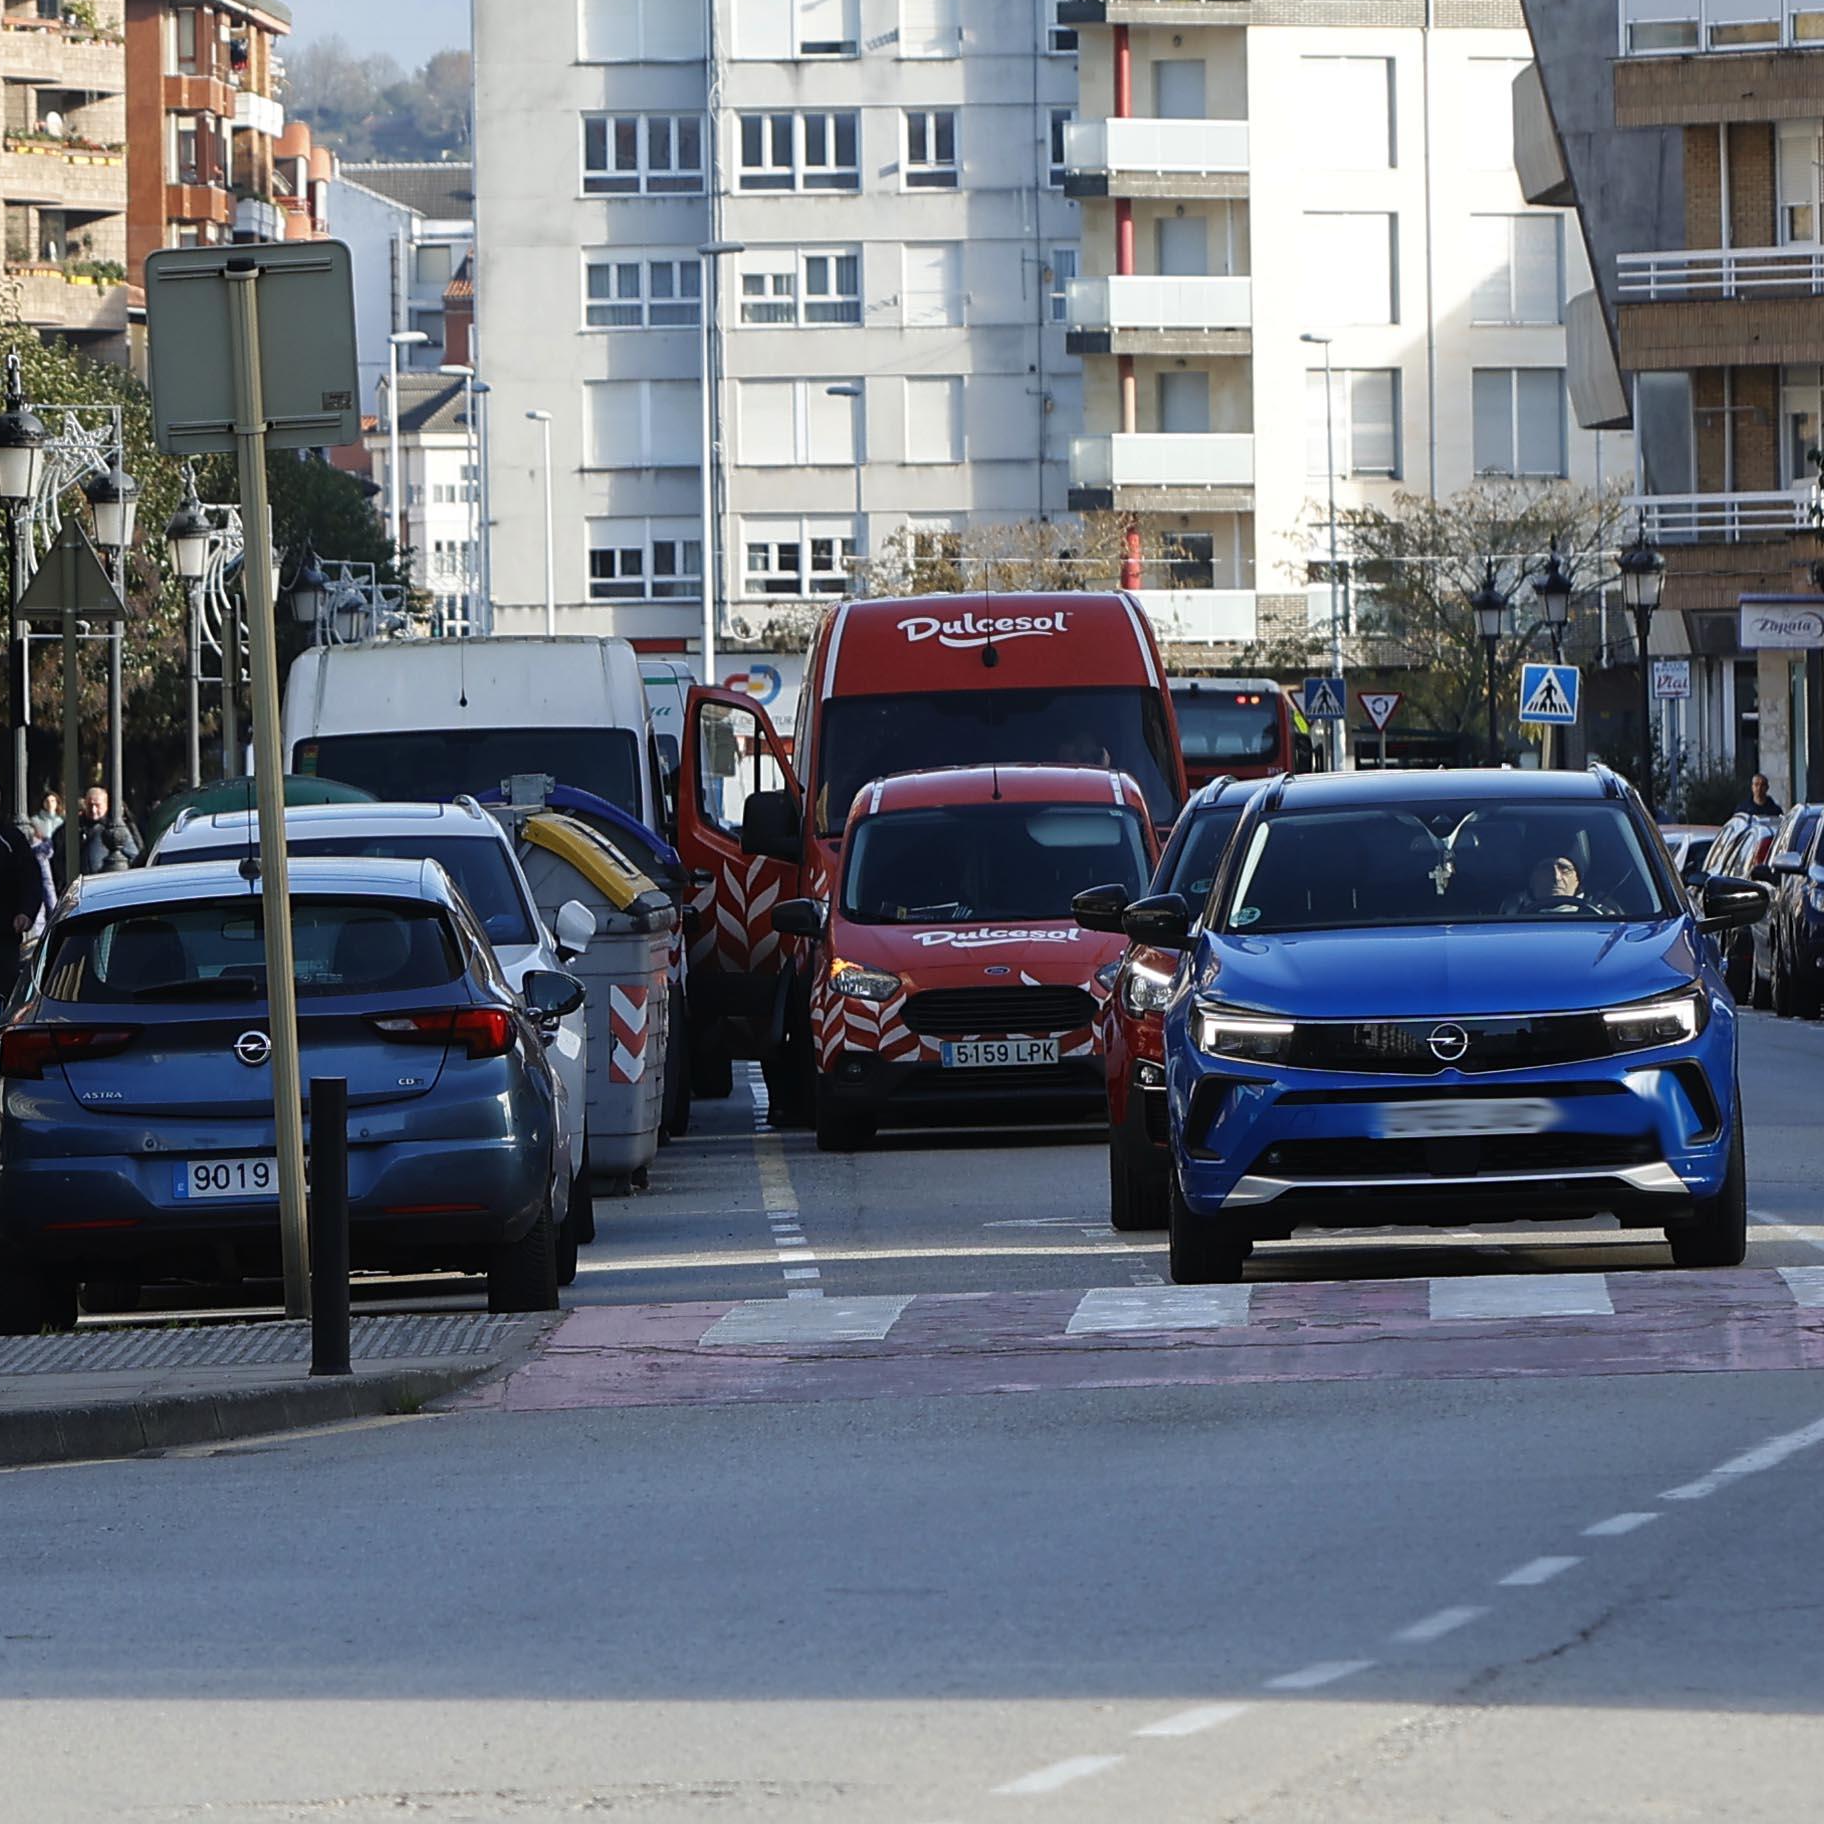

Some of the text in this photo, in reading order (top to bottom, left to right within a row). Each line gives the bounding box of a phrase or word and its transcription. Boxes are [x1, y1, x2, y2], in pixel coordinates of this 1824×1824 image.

[897, 612, 1068, 642] Dulcesol
[912, 928, 1081, 946] Dulcesol
[957, 1042, 1055, 1065] 5159 LPK
[82, 1091, 123, 1100] ASTRA
[193, 1162, 270, 1191] 9019
